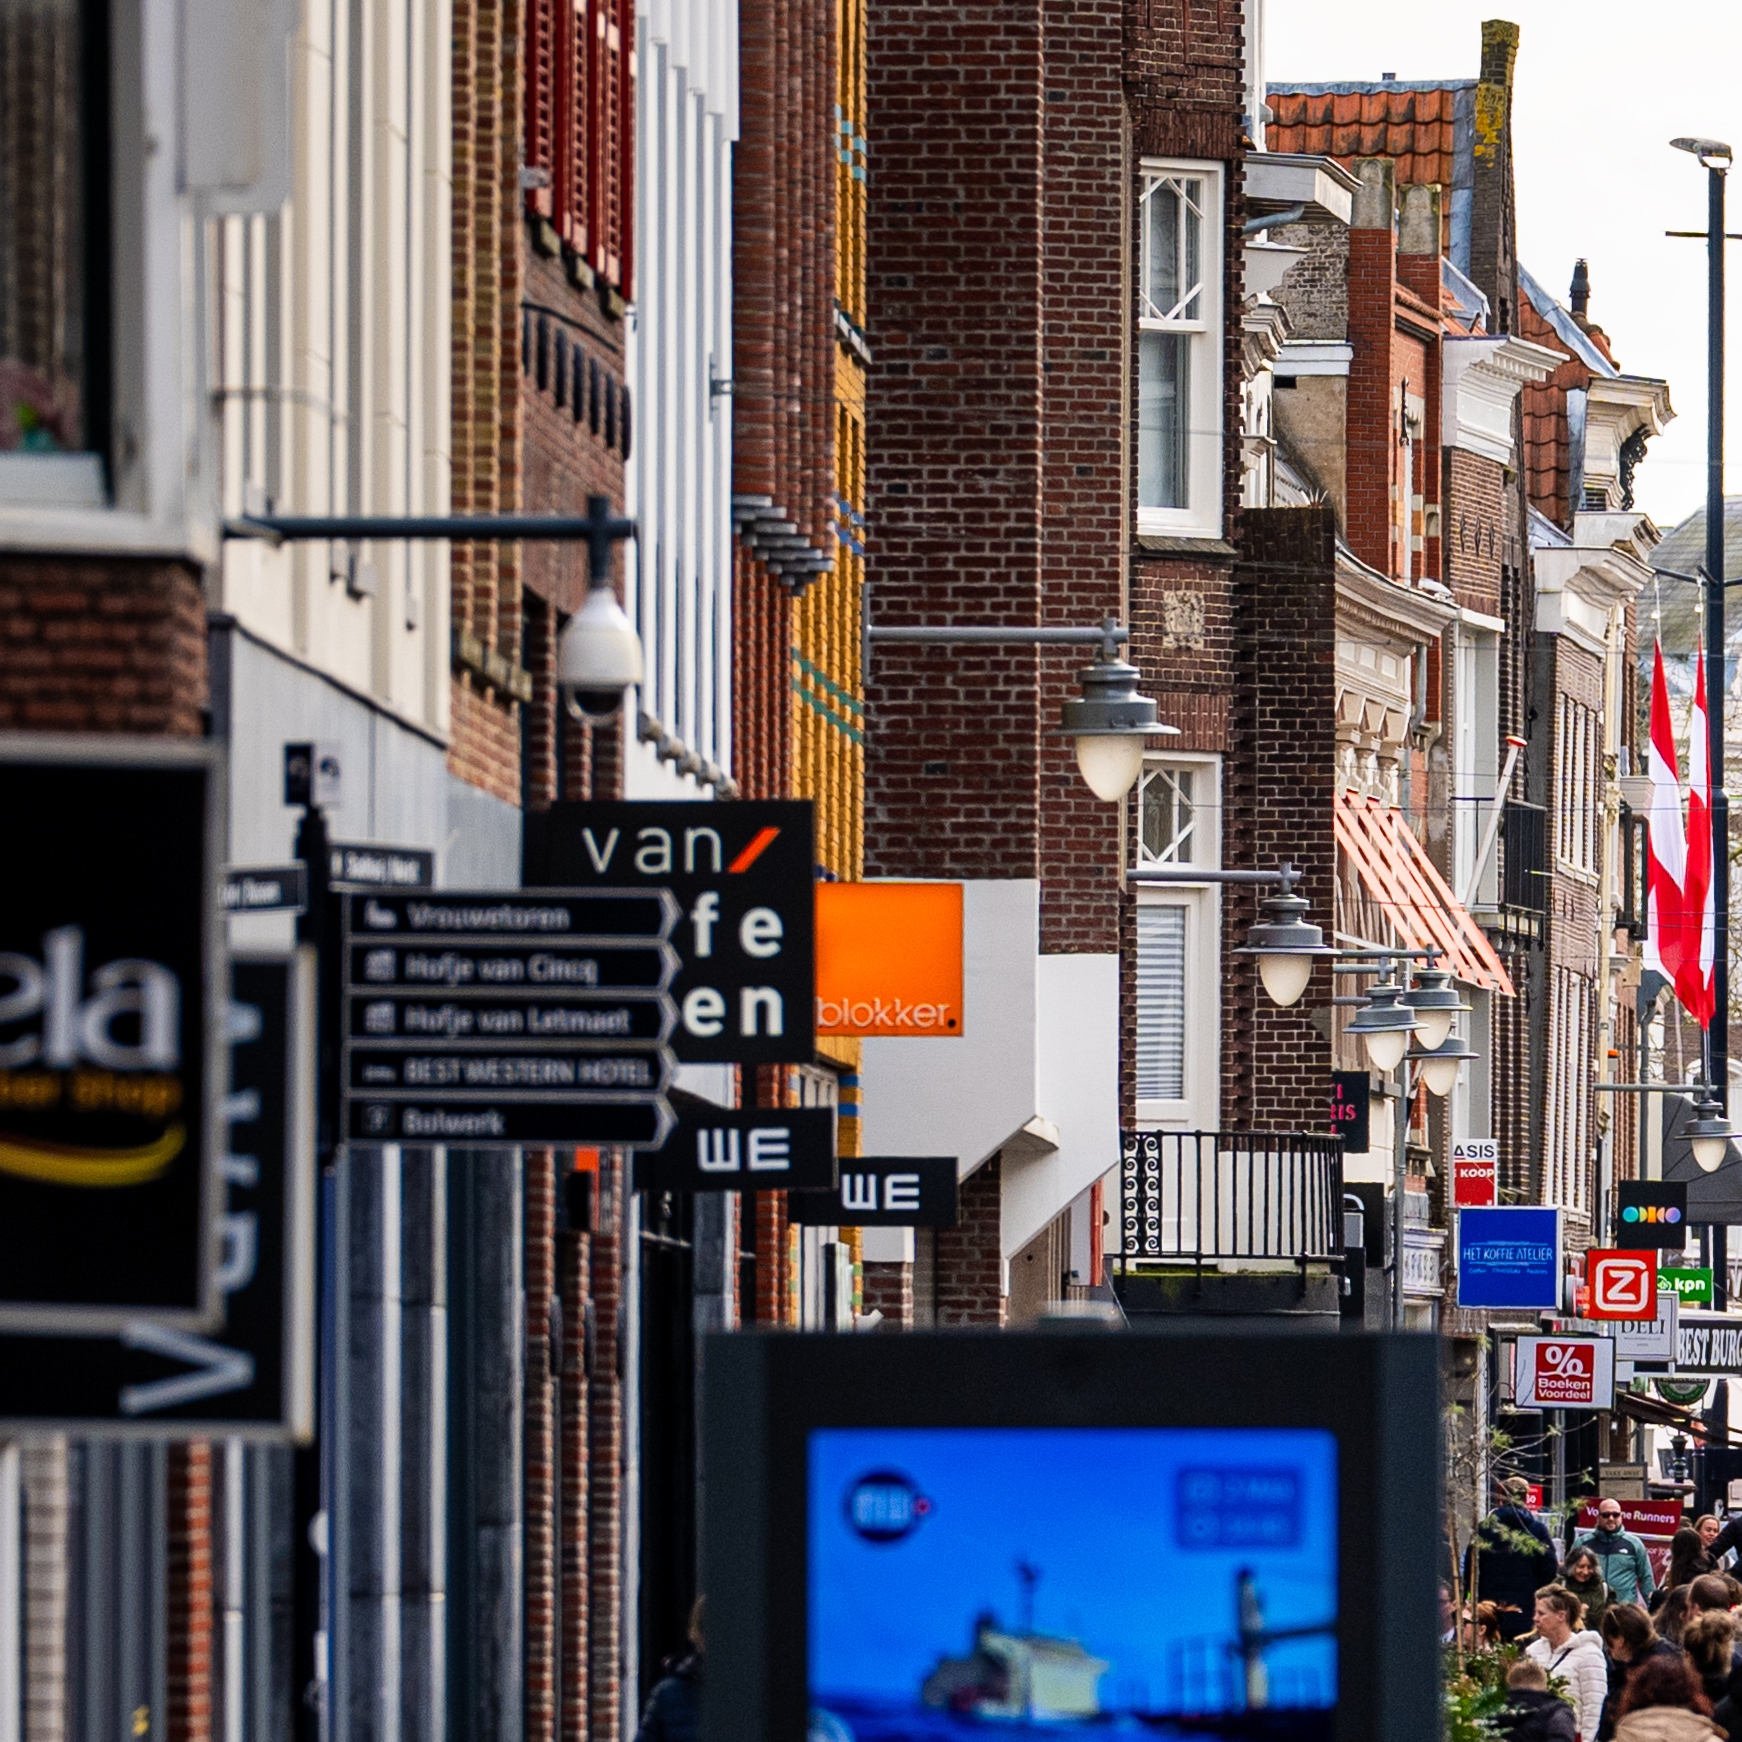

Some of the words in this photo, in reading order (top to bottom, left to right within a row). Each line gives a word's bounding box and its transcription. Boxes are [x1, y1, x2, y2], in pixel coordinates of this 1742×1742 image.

[697, 1127, 790, 1172] WE
[1460, 1168, 1494, 1178] KOOP
[841, 1173, 920, 1211] WE
[1463, 1247, 1481, 1261] HET
[1483, 1247, 1515, 1261] KOFFIE
[1516, 1247, 1554, 1261] ATELIER
[1674, 1277, 1707, 1292] kpn
[1621, 1320, 1667, 1335] DELI
[1678, 1328, 1708, 1366] BEST
[1538, 1378, 1590, 1390] Boeken
[1538, 1390, 1590, 1400] Voordeel
[1633, 1511, 1676, 1524] Runners
